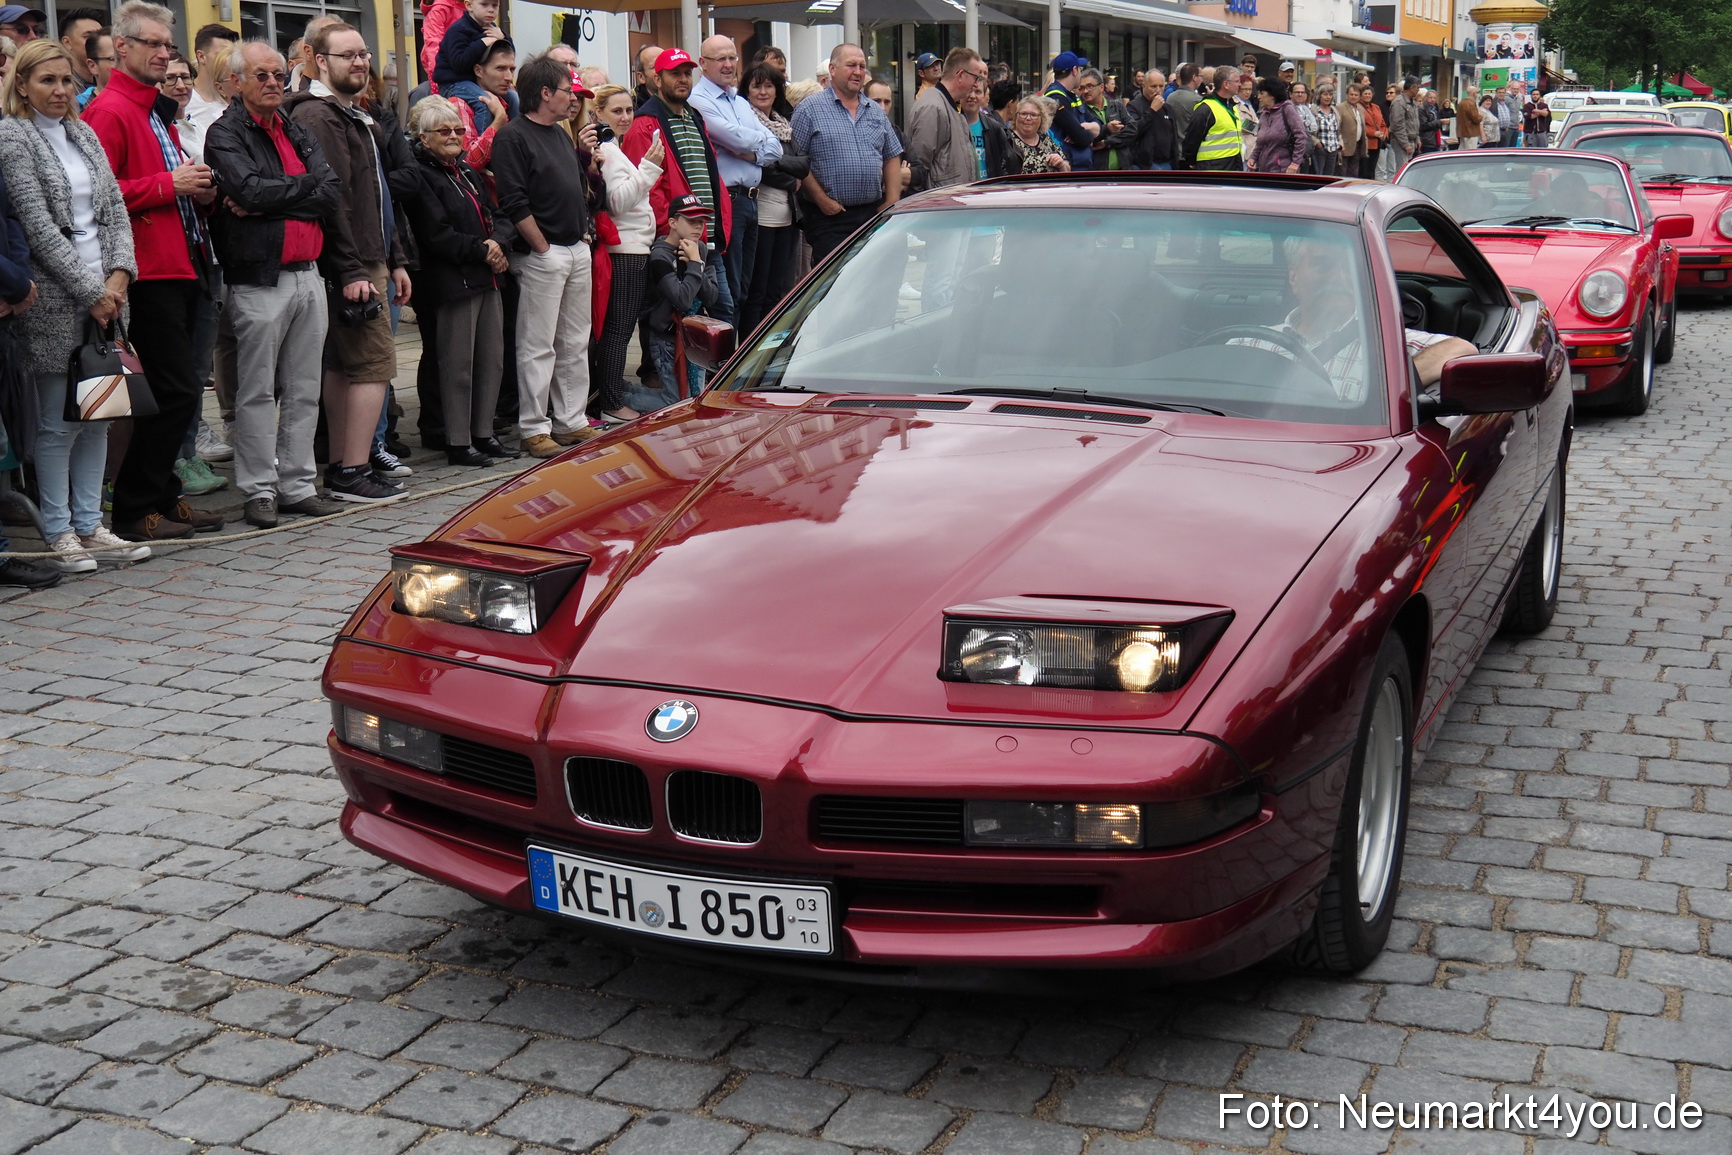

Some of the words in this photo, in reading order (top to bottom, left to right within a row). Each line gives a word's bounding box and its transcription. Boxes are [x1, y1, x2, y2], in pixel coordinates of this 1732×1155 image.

[540, 886, 550, 899] D
[558, 862, 636, 922] KEH
[666, 884, 687, 931] I
[700, 889, 785, 941] 850
[796, 897, 817, 911] 03
[799, 930, 819, 944] 10
